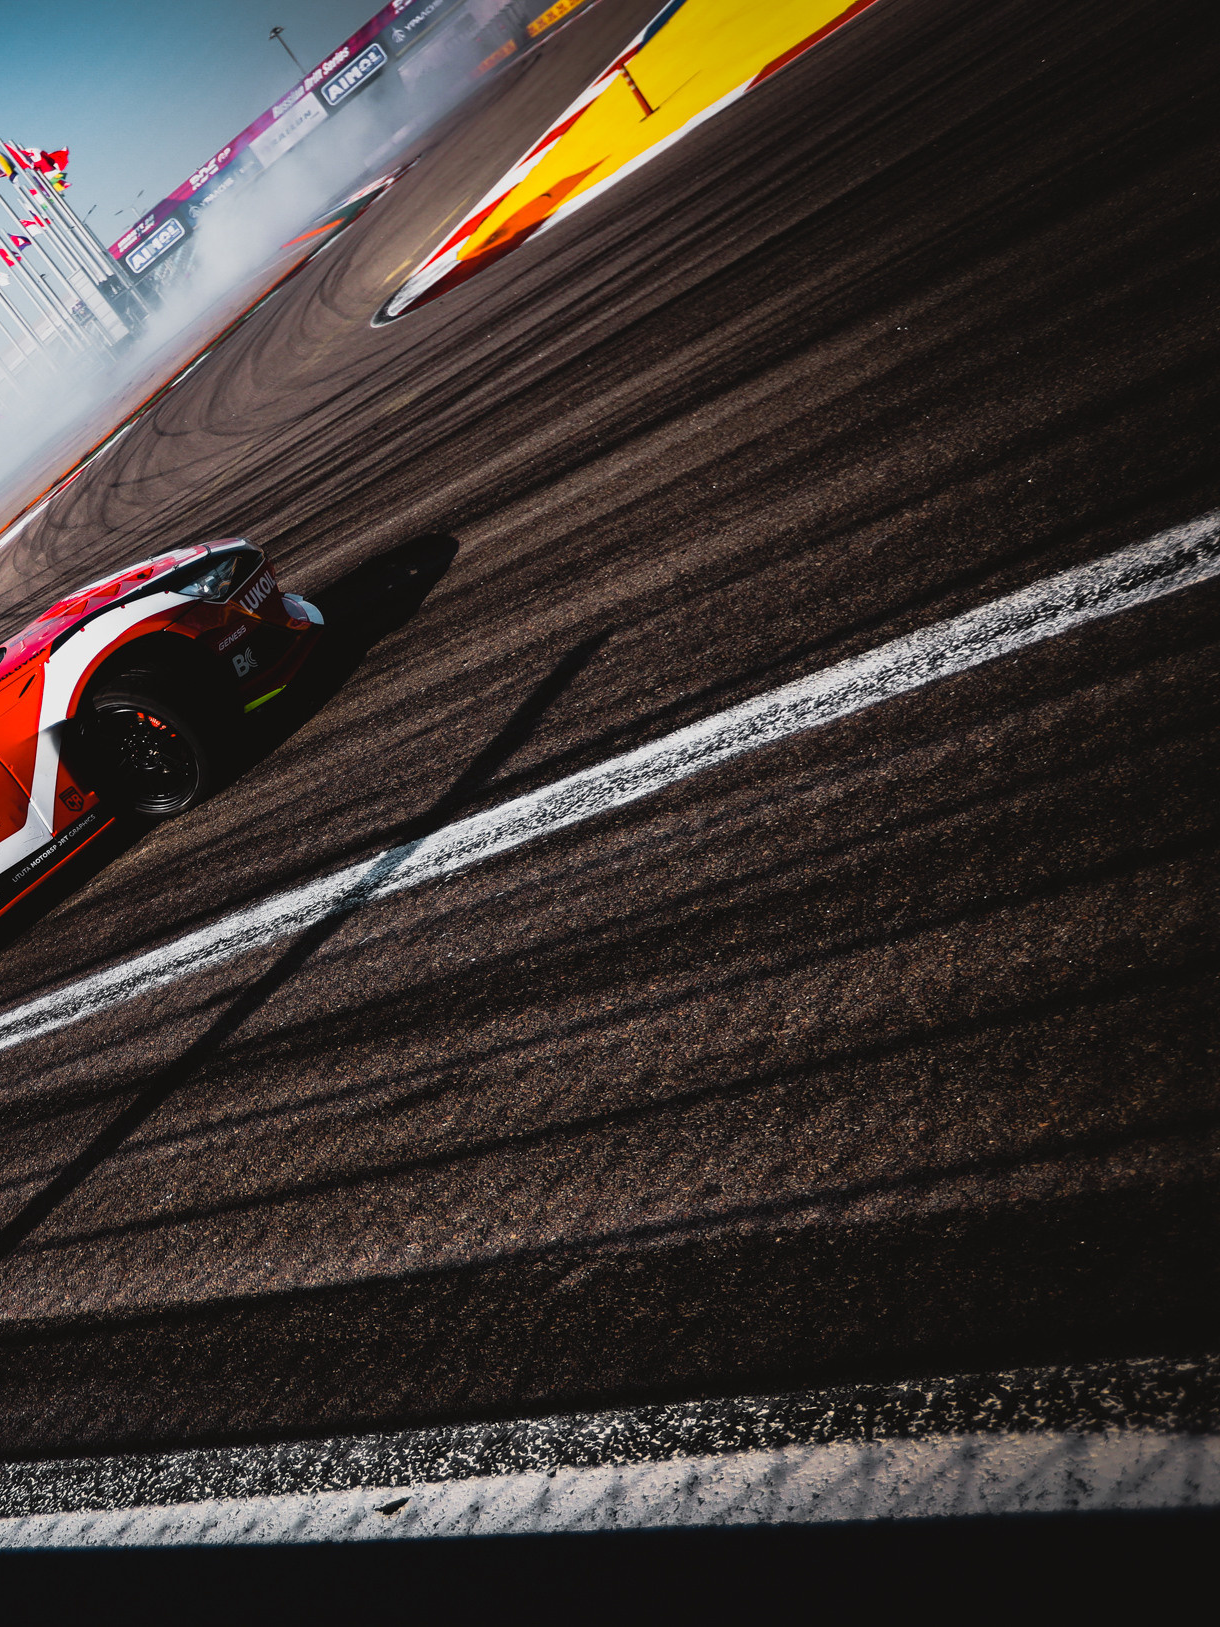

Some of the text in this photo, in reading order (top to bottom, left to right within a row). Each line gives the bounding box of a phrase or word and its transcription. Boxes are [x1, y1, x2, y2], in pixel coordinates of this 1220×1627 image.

[303, 67, 323, 92] Drift
[321, 46, 350, 75] Series
[328, 51, 382, 101] AIMOL
[131, 224, 181, 269] AIMOL
[240, 570, 276, 614] LUKOIL
[218, 625, 247, 651] GENESIS
